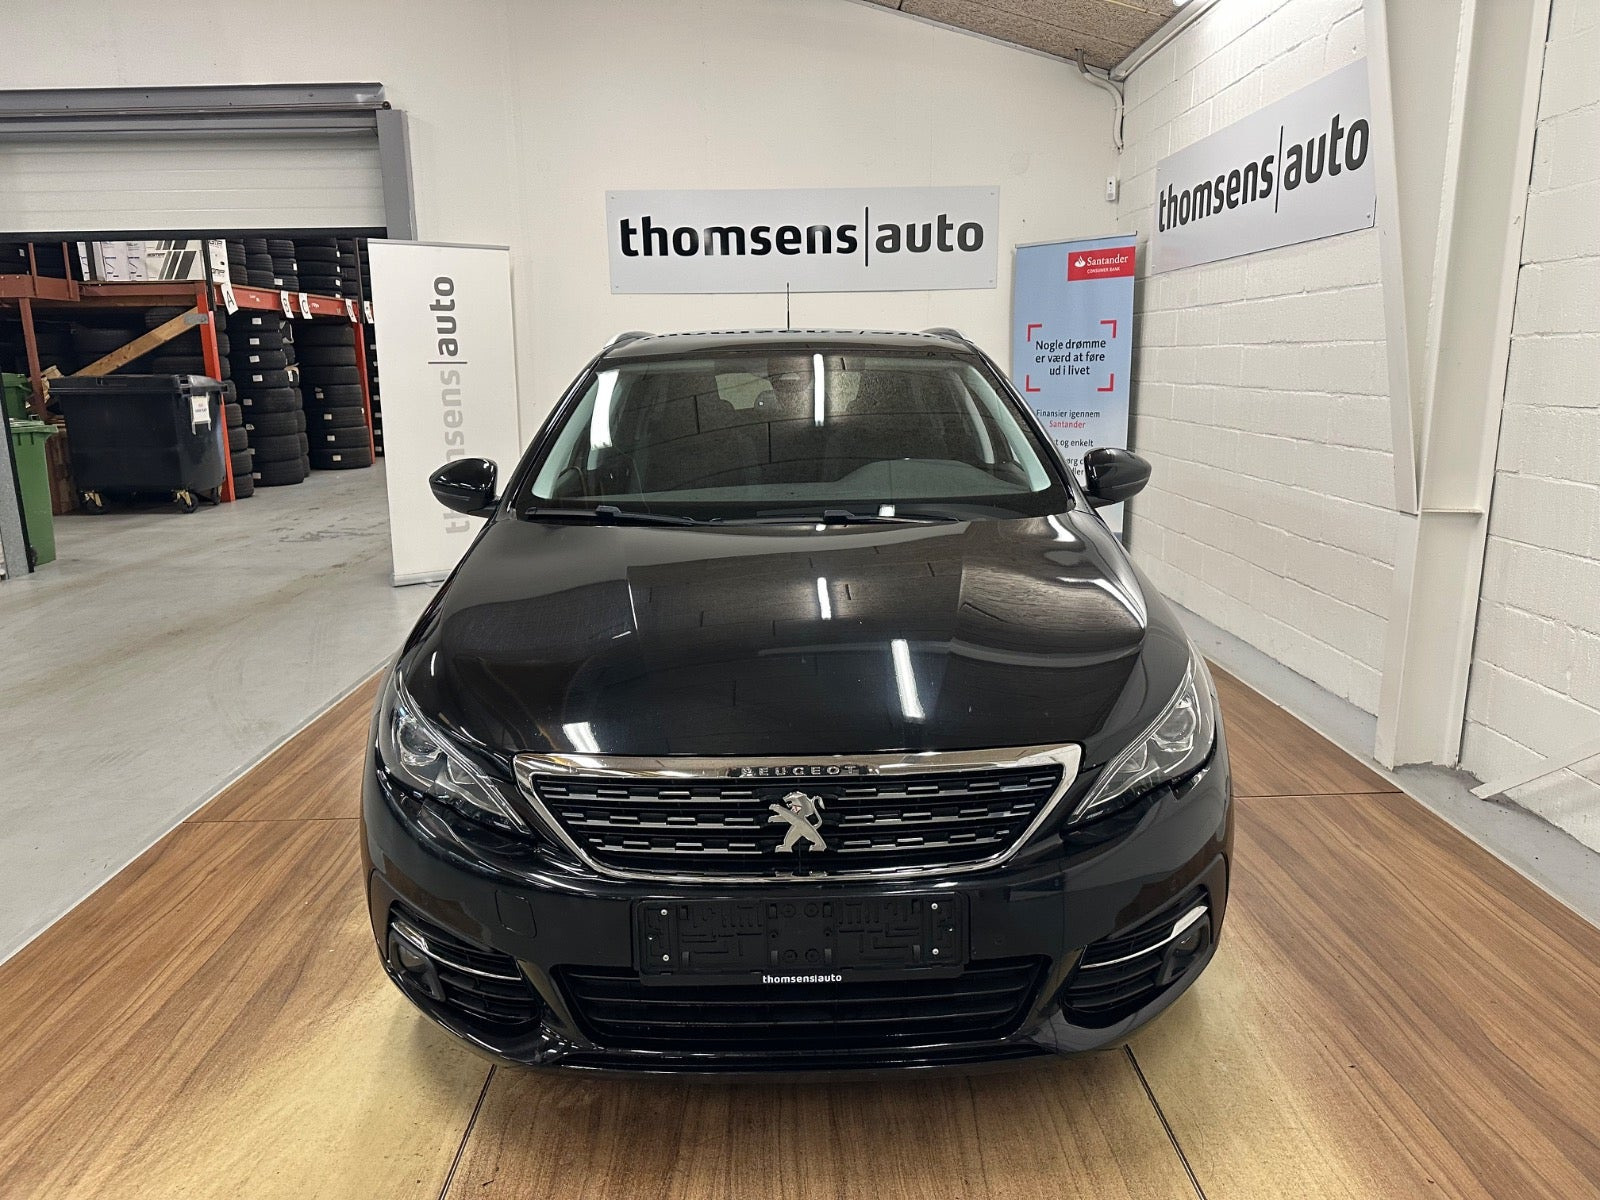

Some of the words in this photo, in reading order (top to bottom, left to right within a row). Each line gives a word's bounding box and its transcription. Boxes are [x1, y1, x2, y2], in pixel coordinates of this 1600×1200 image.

[1086, 253, 1129, 266] Santander
[1035, 339, 1064, 352] Nogle
[1065, 339, 1107, 350] drømme
[1035, 354, 1046, 363] er
[1047, 352, 1072, 363] værd
[1073, 353, 1084, 362] at
[1085, 351, 1105, 362] føre
[1049, 365, 1061, 376] ud
[1068, 365, 1091, 375] livet
[1036, 409, 1068, 418] Finansier
[1069, 410, 1101, 419] igennem
[1049, 421, 1086, 429] Santander
[1060, 440, 1069, 448] og
[1070, 439, 1094, 447] enkelt
